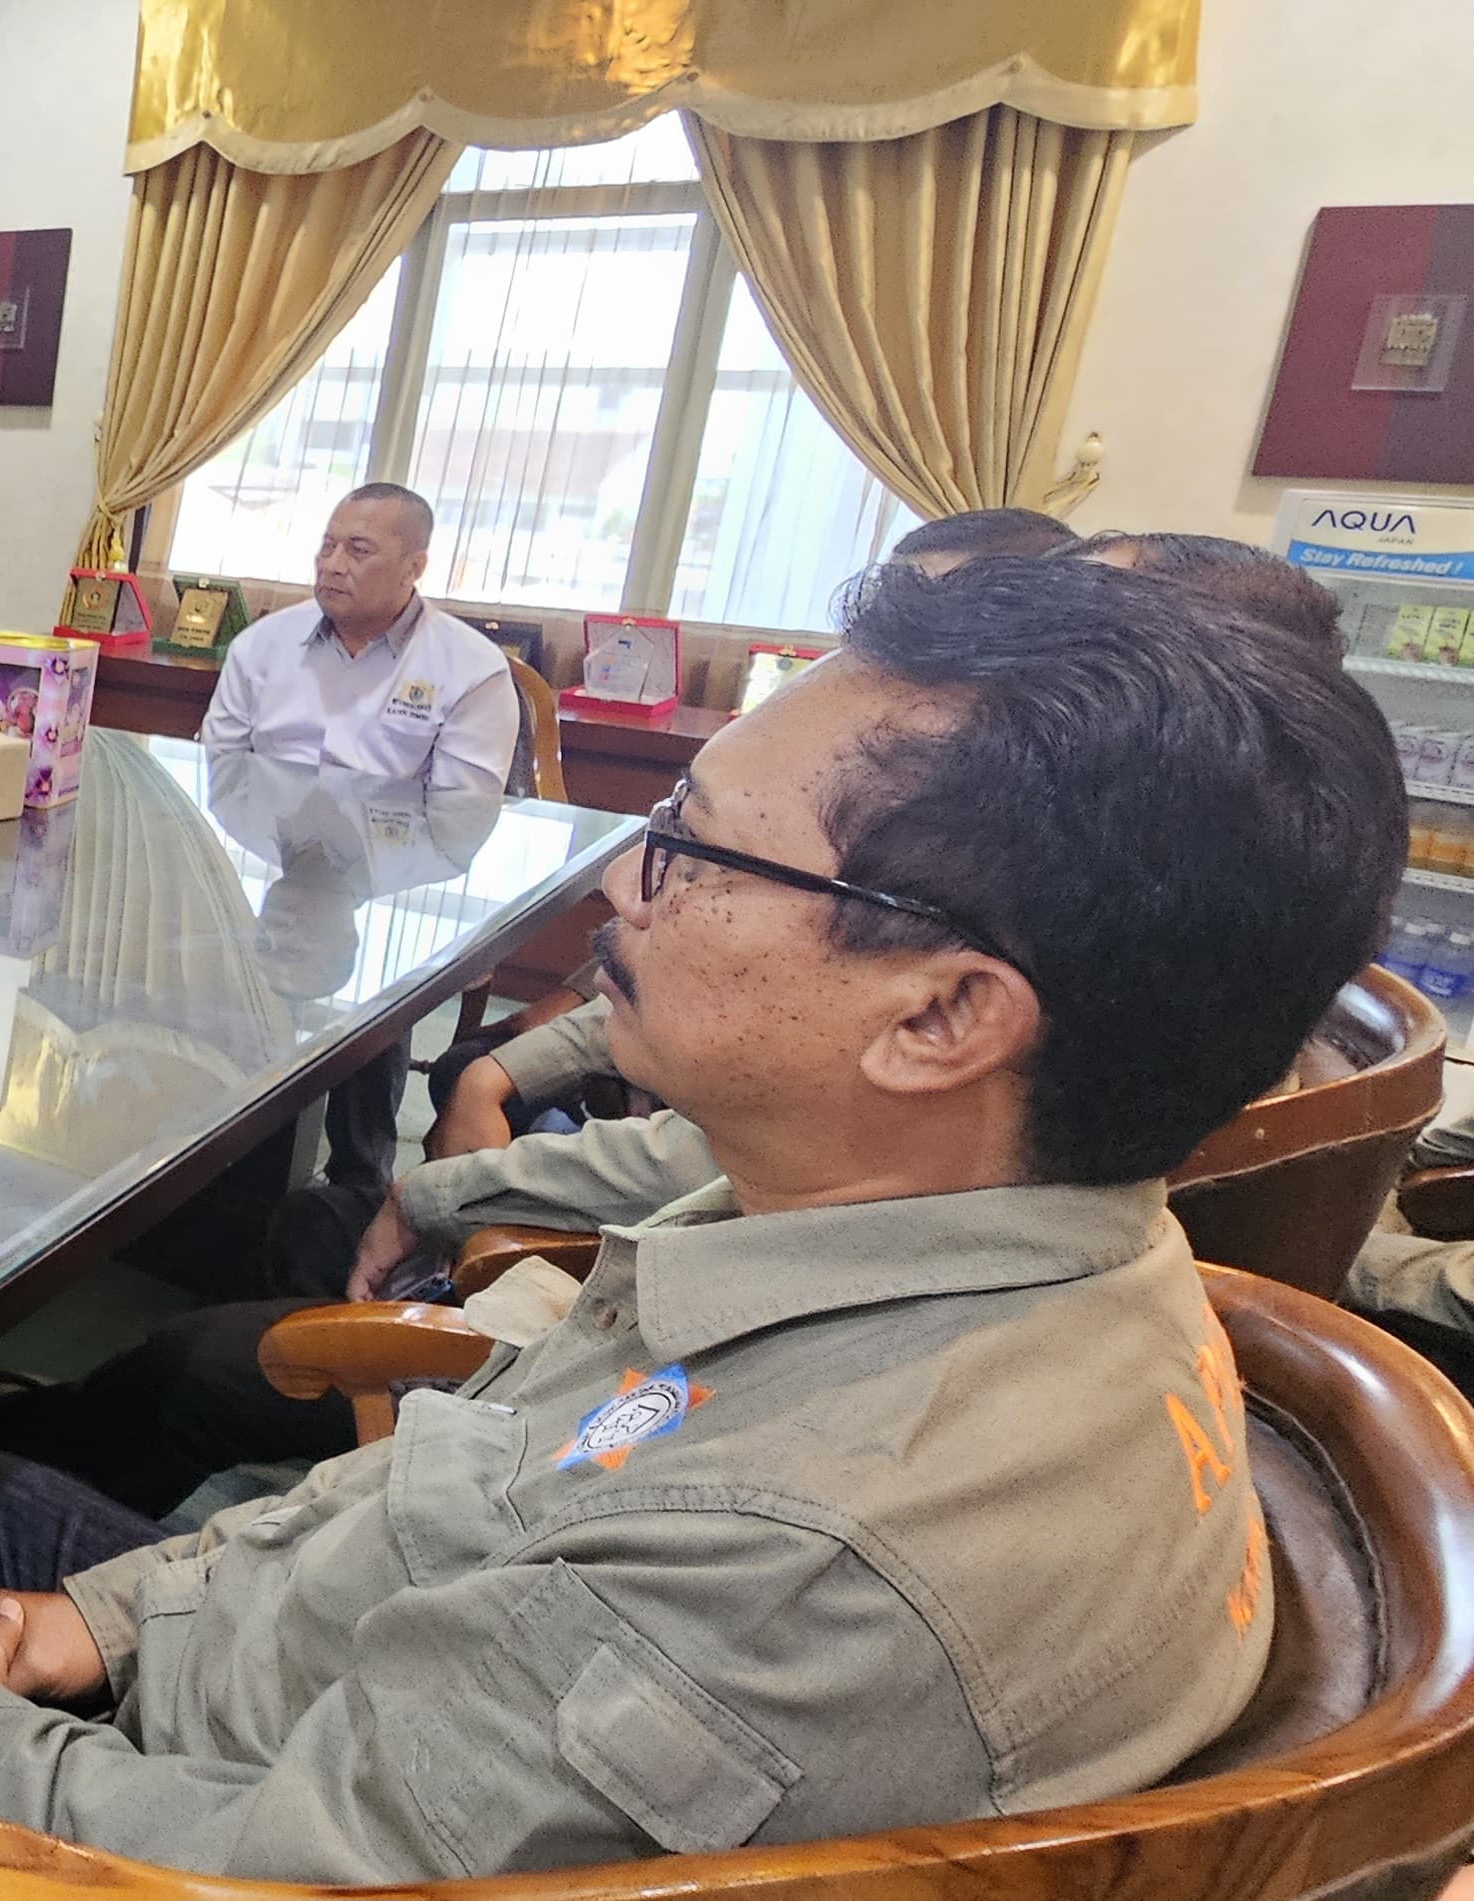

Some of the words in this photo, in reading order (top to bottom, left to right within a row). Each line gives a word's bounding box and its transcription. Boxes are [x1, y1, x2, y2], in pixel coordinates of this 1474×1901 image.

[1312, 510, 1415, 533] AQUA
[1378, 537, 1414, 545] JAPAN
[1301, 549, 1344, 566] Stay
